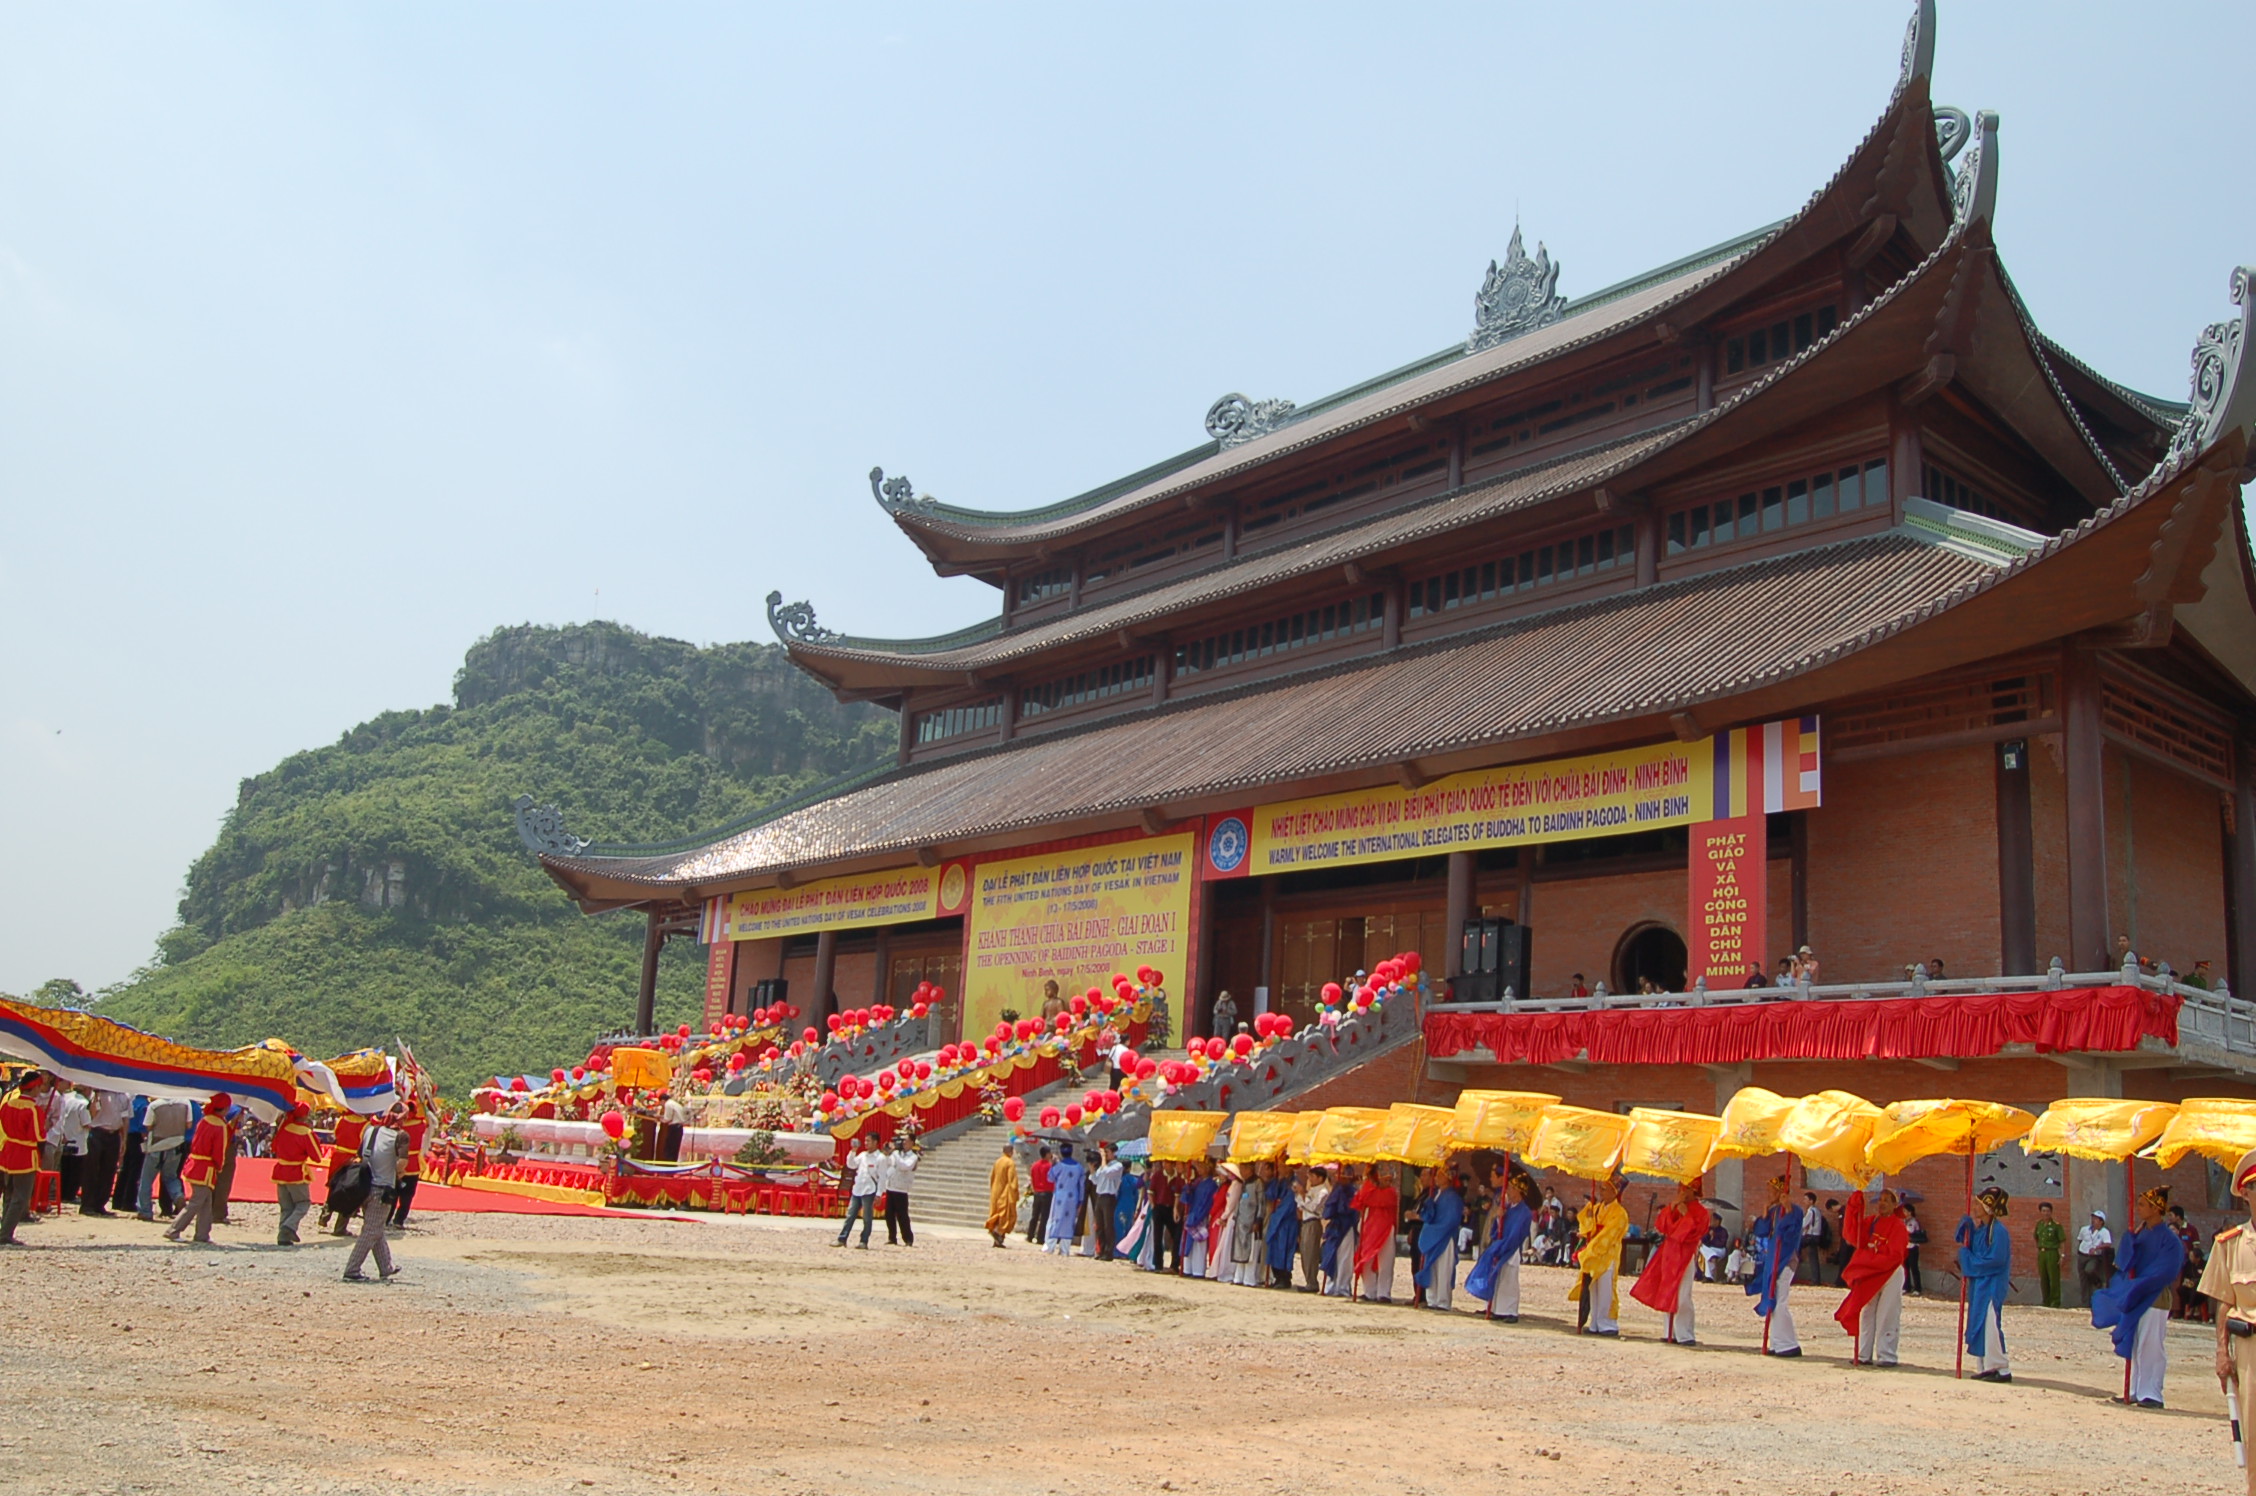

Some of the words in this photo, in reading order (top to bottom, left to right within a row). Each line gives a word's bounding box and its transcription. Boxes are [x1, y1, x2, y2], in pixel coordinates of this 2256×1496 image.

[1361, 798, 1376, 827] CÁC
[1387, 800, 1400, 830] ĐẠI
[1424, 788, 1446, 823] PHẬT
[1447, 783, 1467, 815] GIÁO
[1469, 775, 1495, 811] QUỐC
[1499, 772, 1510, 808] TẾ
[1512, 770, 1532, 806] ĐẾN
[1535, 771, 1551, 803] VỚI
[1554, 768, 1580, 801] CHÙA
[1583, 765, 1600, 797] BÁI
[1602, 761, 1627, 795] ĐÍNH
[1635, 761, 1659, 791] NINH
[1663, 752, 1688, 786] BÌNH
[1269, 846, 1300, 865] WARMLY
[1302, 841, 1339, 860] WELCOME
[1341, 839, 1356, 856] THE
[1359, 831, 1420, 855] INTERNATIONAL
[1422, 823, 1470, 846] DELEGATES
[1472, 822, 1483, 840] OF
[1486, 818, 1525, 838] BUDDHA
[1529, 816, 1541, 834] TO
[1544, 810, 1583, 833] BAIDINH
[1586, 805, 1627, 828] PAGODA
[1635, 800, 1660, 821] NINH
[1663, 795, 1688, 817] BINH
[1706, 833, 1746, 847] PHẬT
[1708, 844, 1745, 860] GIÁO
[1051, 864, 1071, 882] LIÊN
[1092, 854, 1118, 877] QUỐC
[1120, 858, 1136, 876] TẠI
[1138, 852, 1159, 873] VIỆT
[1161, 851, 1182, 867] NAM
[1716, 858, 1736, 872] VÀ
[1716, 871, 1736, 885] XÃ
[884, 875, 908, 899] QUỐC
[909, 878, 929, 895] 2008
[983, 897, 994, 907] THE
[1014, 891, 1039, 902] UNITED
[1041, 886, 1072, 899] NATIONS
[1074, 884, 1089, 895] DAY
[1091, 882, 1102, 892] OF
[1104, 879, 1130, 891] VESAK
[1132, 877, 1141, 887] IN
[1144, 872, 1180, 886] VIETNAM
[1713, 885, 1739, 899] HỘI
[838, 910, 846, 920] OF
[847, 908, 866, 920] VESAK
[867, 903, 911, 917] CELEBRATIONS
[1704, 899, 1747, 912] CÔNG
[1705, 910, 1747, 925] BẰNG
[977, 925, 1007, 949] KHÁNH
[1118, 914, 1139, 936] GIAI
[1141, 912, 1170, 937] ĐOẠN
[1710, 924, 1742, 937] DÂN
[1709, 935, 1742, 950] CHỦ
[977, 954, 993, 968] THE
[994, 950, 1036, 966] OPENNING
[1038, 948, 1050, 962] OF
[1052, 945, 1088, 961] BAIDINH
[1090, 942, 1128, 958] PAGODA
[1136, 939, 1167, 955] STAGE
[1710, 951, 1742, 963] VĂN
[1706, 965, 1746, 977] MINH
